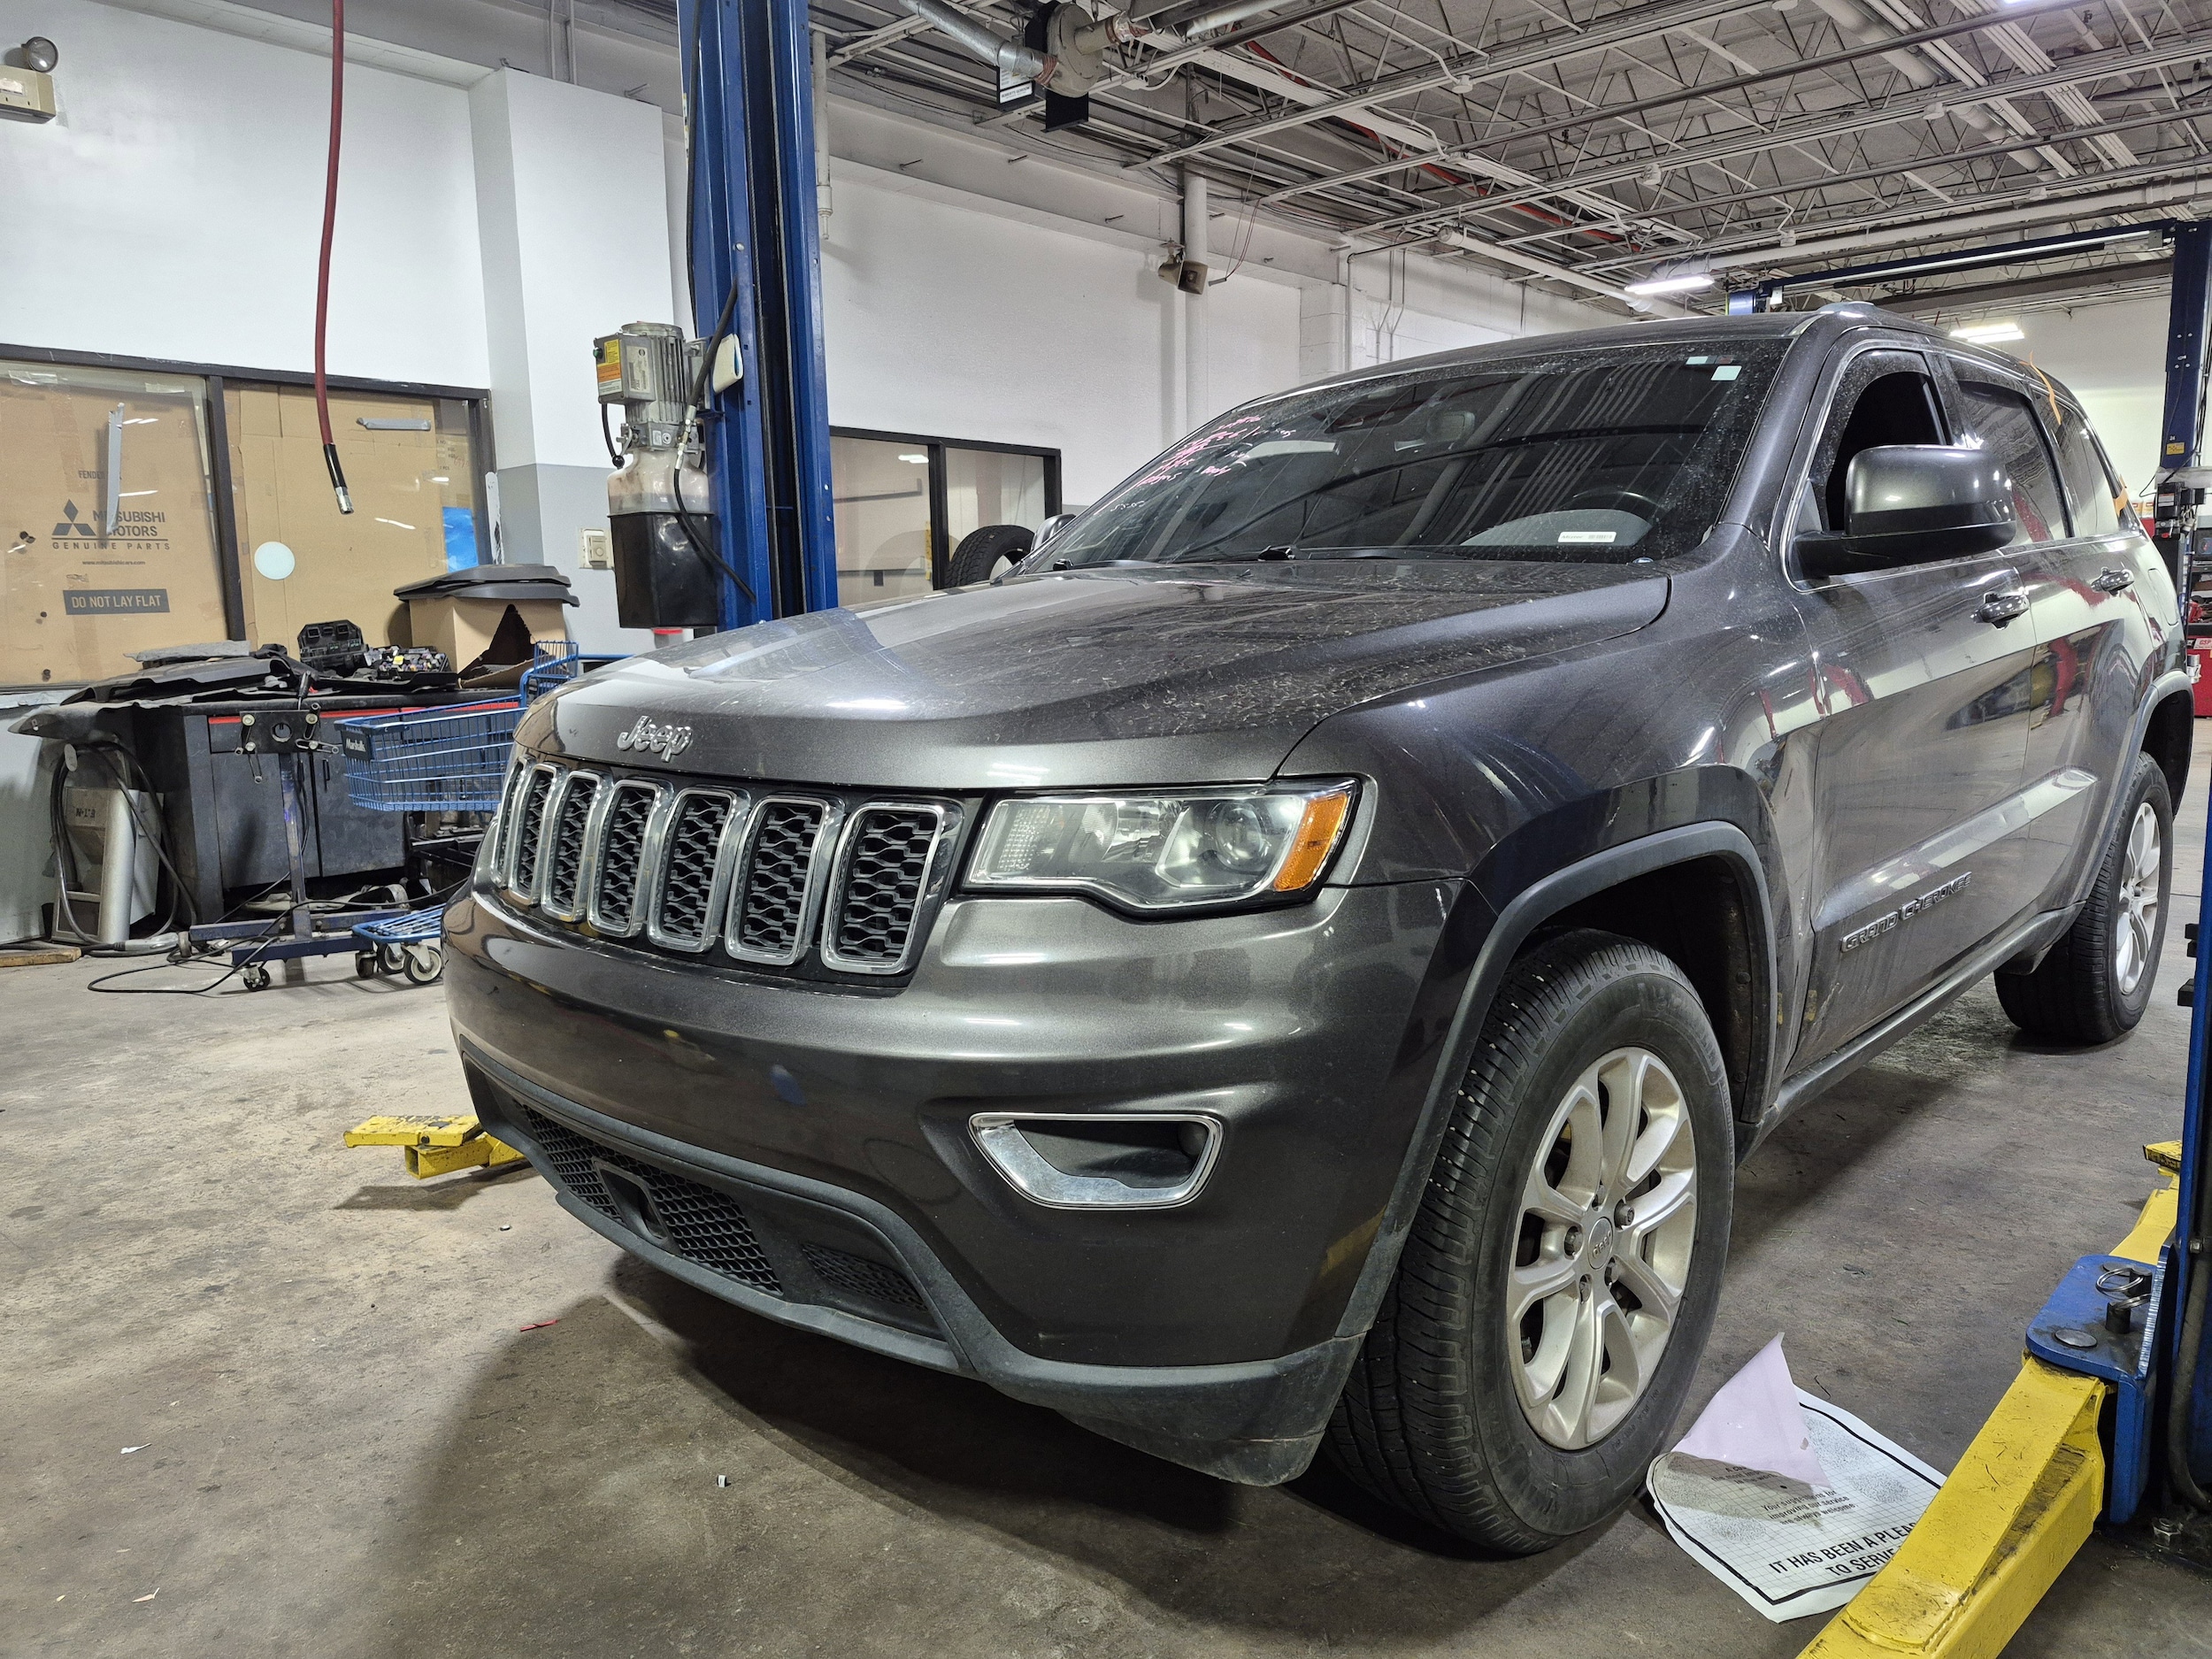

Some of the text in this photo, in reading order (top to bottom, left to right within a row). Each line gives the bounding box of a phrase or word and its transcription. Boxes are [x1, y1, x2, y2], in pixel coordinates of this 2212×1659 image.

[51, 541, 118, 550] GENUINE
[71, 595, 161, 609] DO NOT LAY FLAT
[617, 715, 692, 763] Jeep
[1841, 871, 1972, 953] GRAND CHEROKEE
[1821, 1495, 1850, 1506] service
[1793, 1510, 1823, 1522] always
[1768, 1560, 1788, 1574] IT
[1786, 1552, 1824, 1569] HAS
[1819, 1540, 1865, 1561] BEEN
[1862, 1536, 1879, 1548] A
[1825, 1563, 1853, 1577] TO
